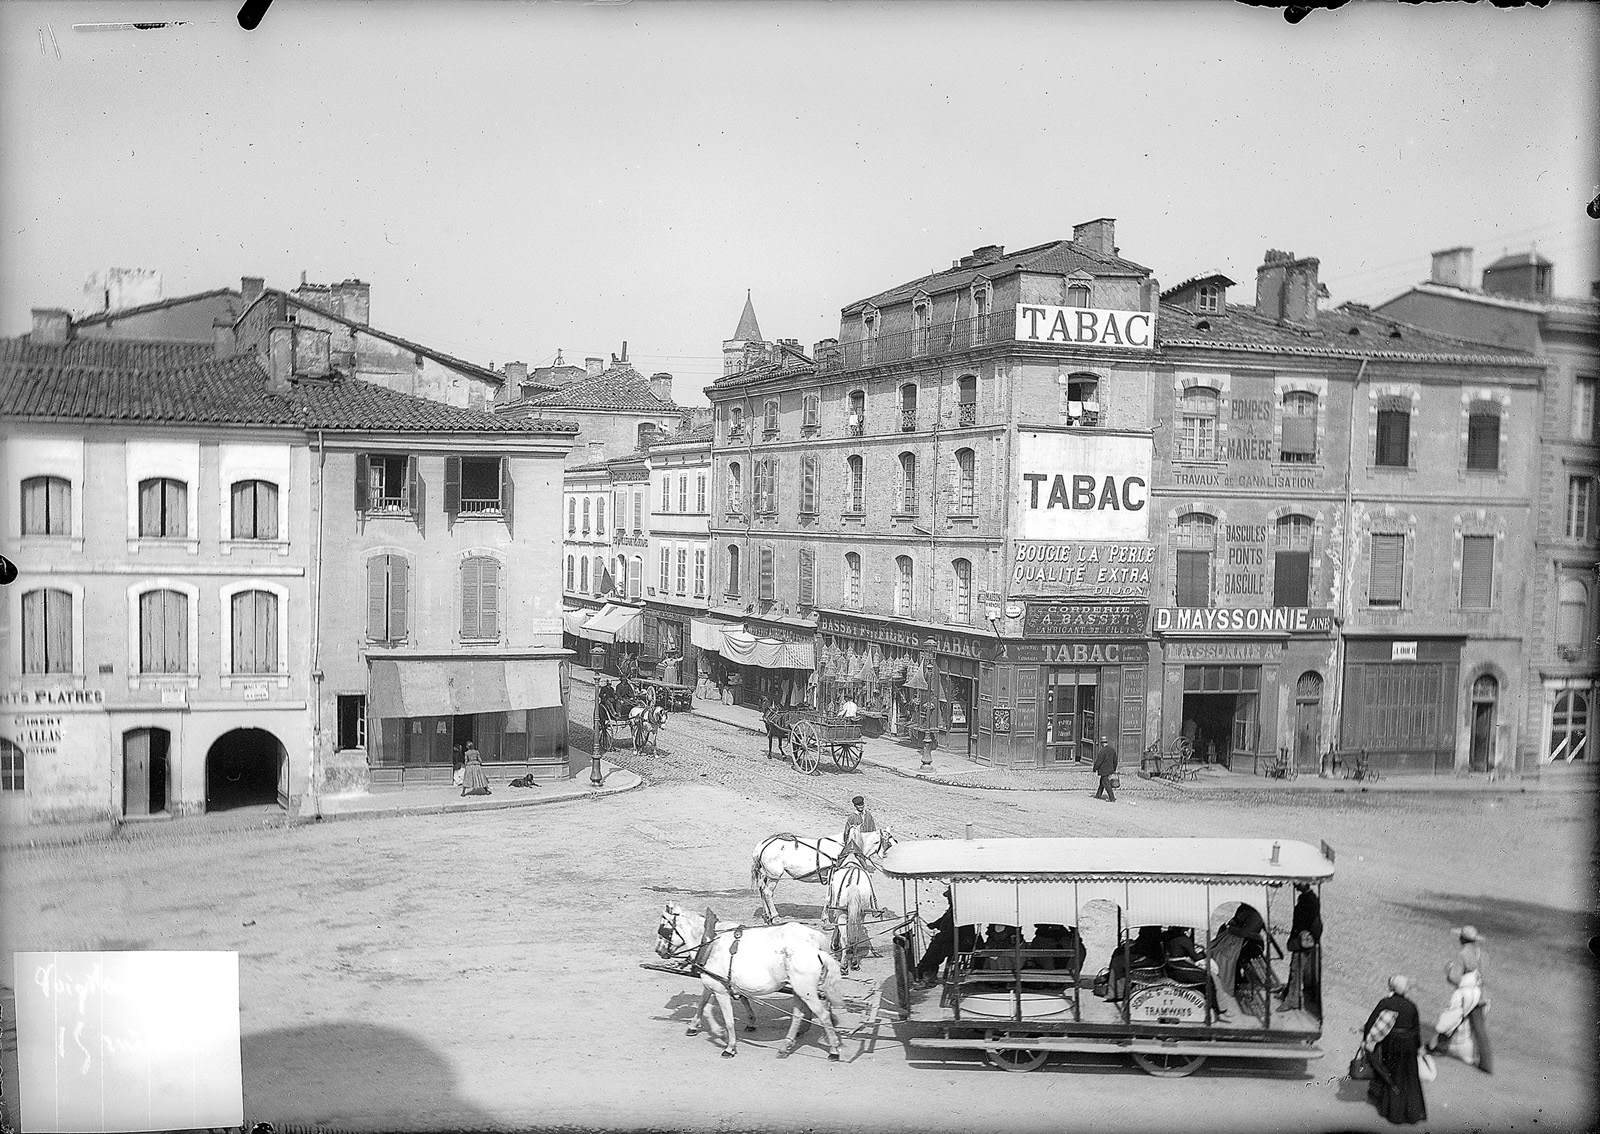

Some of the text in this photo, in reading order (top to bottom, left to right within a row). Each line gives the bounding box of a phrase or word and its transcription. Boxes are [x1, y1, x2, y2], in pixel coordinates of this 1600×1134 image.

[1022, 307, 1150, 347] TABAC
[1231, 398, 1270, 421] POMPES
[1174, 473, 1220, 487] TRAVAUX
[1238, 474, 1315, 489] CANALISATION
[1023, 473, 1146, 511] TABAC
[1226, 524, 1267, 543] BASCULES
[1015, 543, 1157, 564] BOUGIE LA PERLE
[1228, 547, 1263, 565] PONTS
[1013, 563, 1151, 584] QUALITÉ EXTRA
[1093, 586, 1146, 596] DIJON
[1225, 574, 1265, 594] BASCULE
[1062, 613, 1134, 626] BASSET
[1177, 608, 1309, 630] MAYSSONNIE
[935, 633, 982, 659] TABAC
[1042, 643, 1120, 662] TABAC
[1174, 987, 1205, 1009] OMNIBUS
[1144, 1006, 1193, 1017] TRAMWAYS
